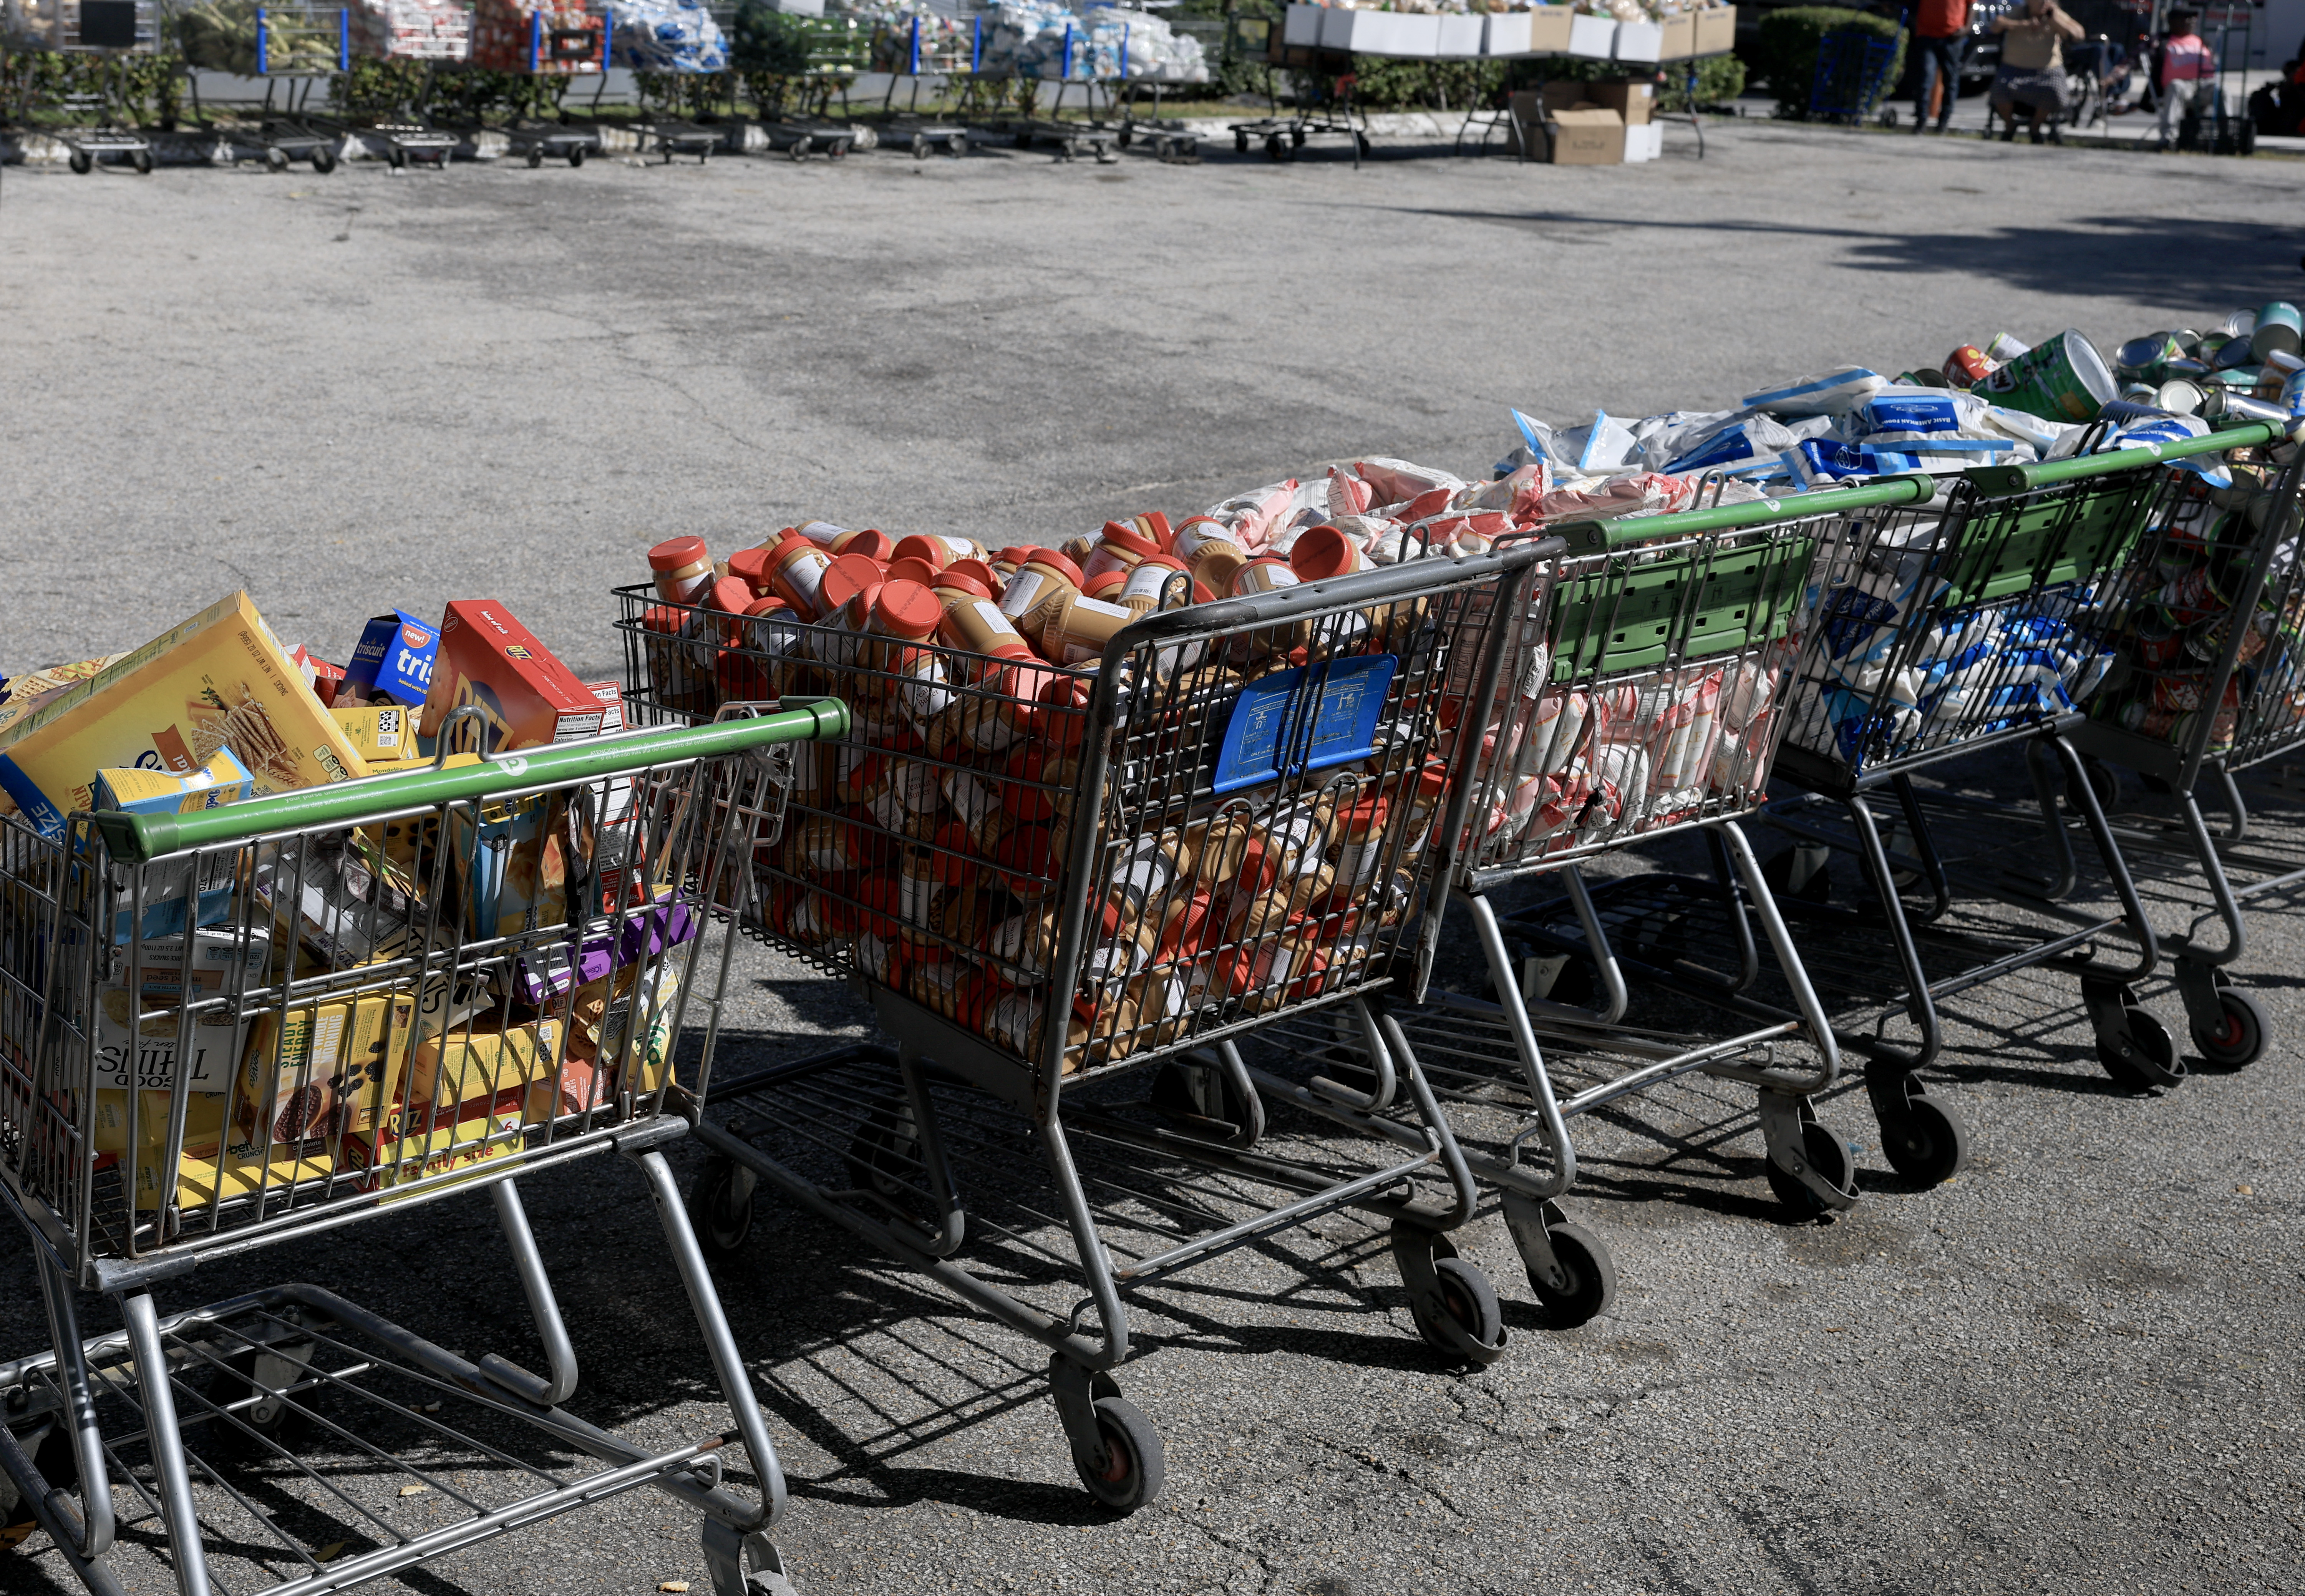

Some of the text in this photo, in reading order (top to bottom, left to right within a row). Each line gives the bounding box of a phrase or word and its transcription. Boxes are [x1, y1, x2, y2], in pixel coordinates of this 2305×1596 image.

[445, 619, 458, 630] NABISCO
[481, 611, 491, 620] hint
[496, 624, 509, 634] salt
[405, 630, 425, 643] new!
[357, 641, 385, 657] triscuit
[506, 645, 532, 660] RITZ
[237, 629, 289, 697] SNACKS NET WT 20 OZ (566g)
[398, 678, 412, 687] baked
[411, 684, 421, 692] with
[589, 745, 620, 756] ATENCIÓN:
[651, 738, 671, 747] compras
[612, 751, 630, 759] llevado
[693, 733, 733, 745] estacionamiento.
[196, 793, 206, 805] SHELLS
[303, 792, 322, 800] purse
[324, 785, 366, 795] unattended.
[348, 791, 385, 801] desatendido.
[30, 799, 68, 845] SIZE
[223, 866, 237, 884] Facts
[197, 877, 209, 892] 370
[541, 909, 549, 924] CHEESE
[311, 1017, 330, 1046] WHOLE
[318, 1014, 347, 1063] MORNING
[286, 1019, 316, 1068] ENERGY
[245, 1049, 257, 1076] CRUNCHY
[245, 1048, 264, 1088] belVita
[234, 1096, 247, 1122] Chocolate
